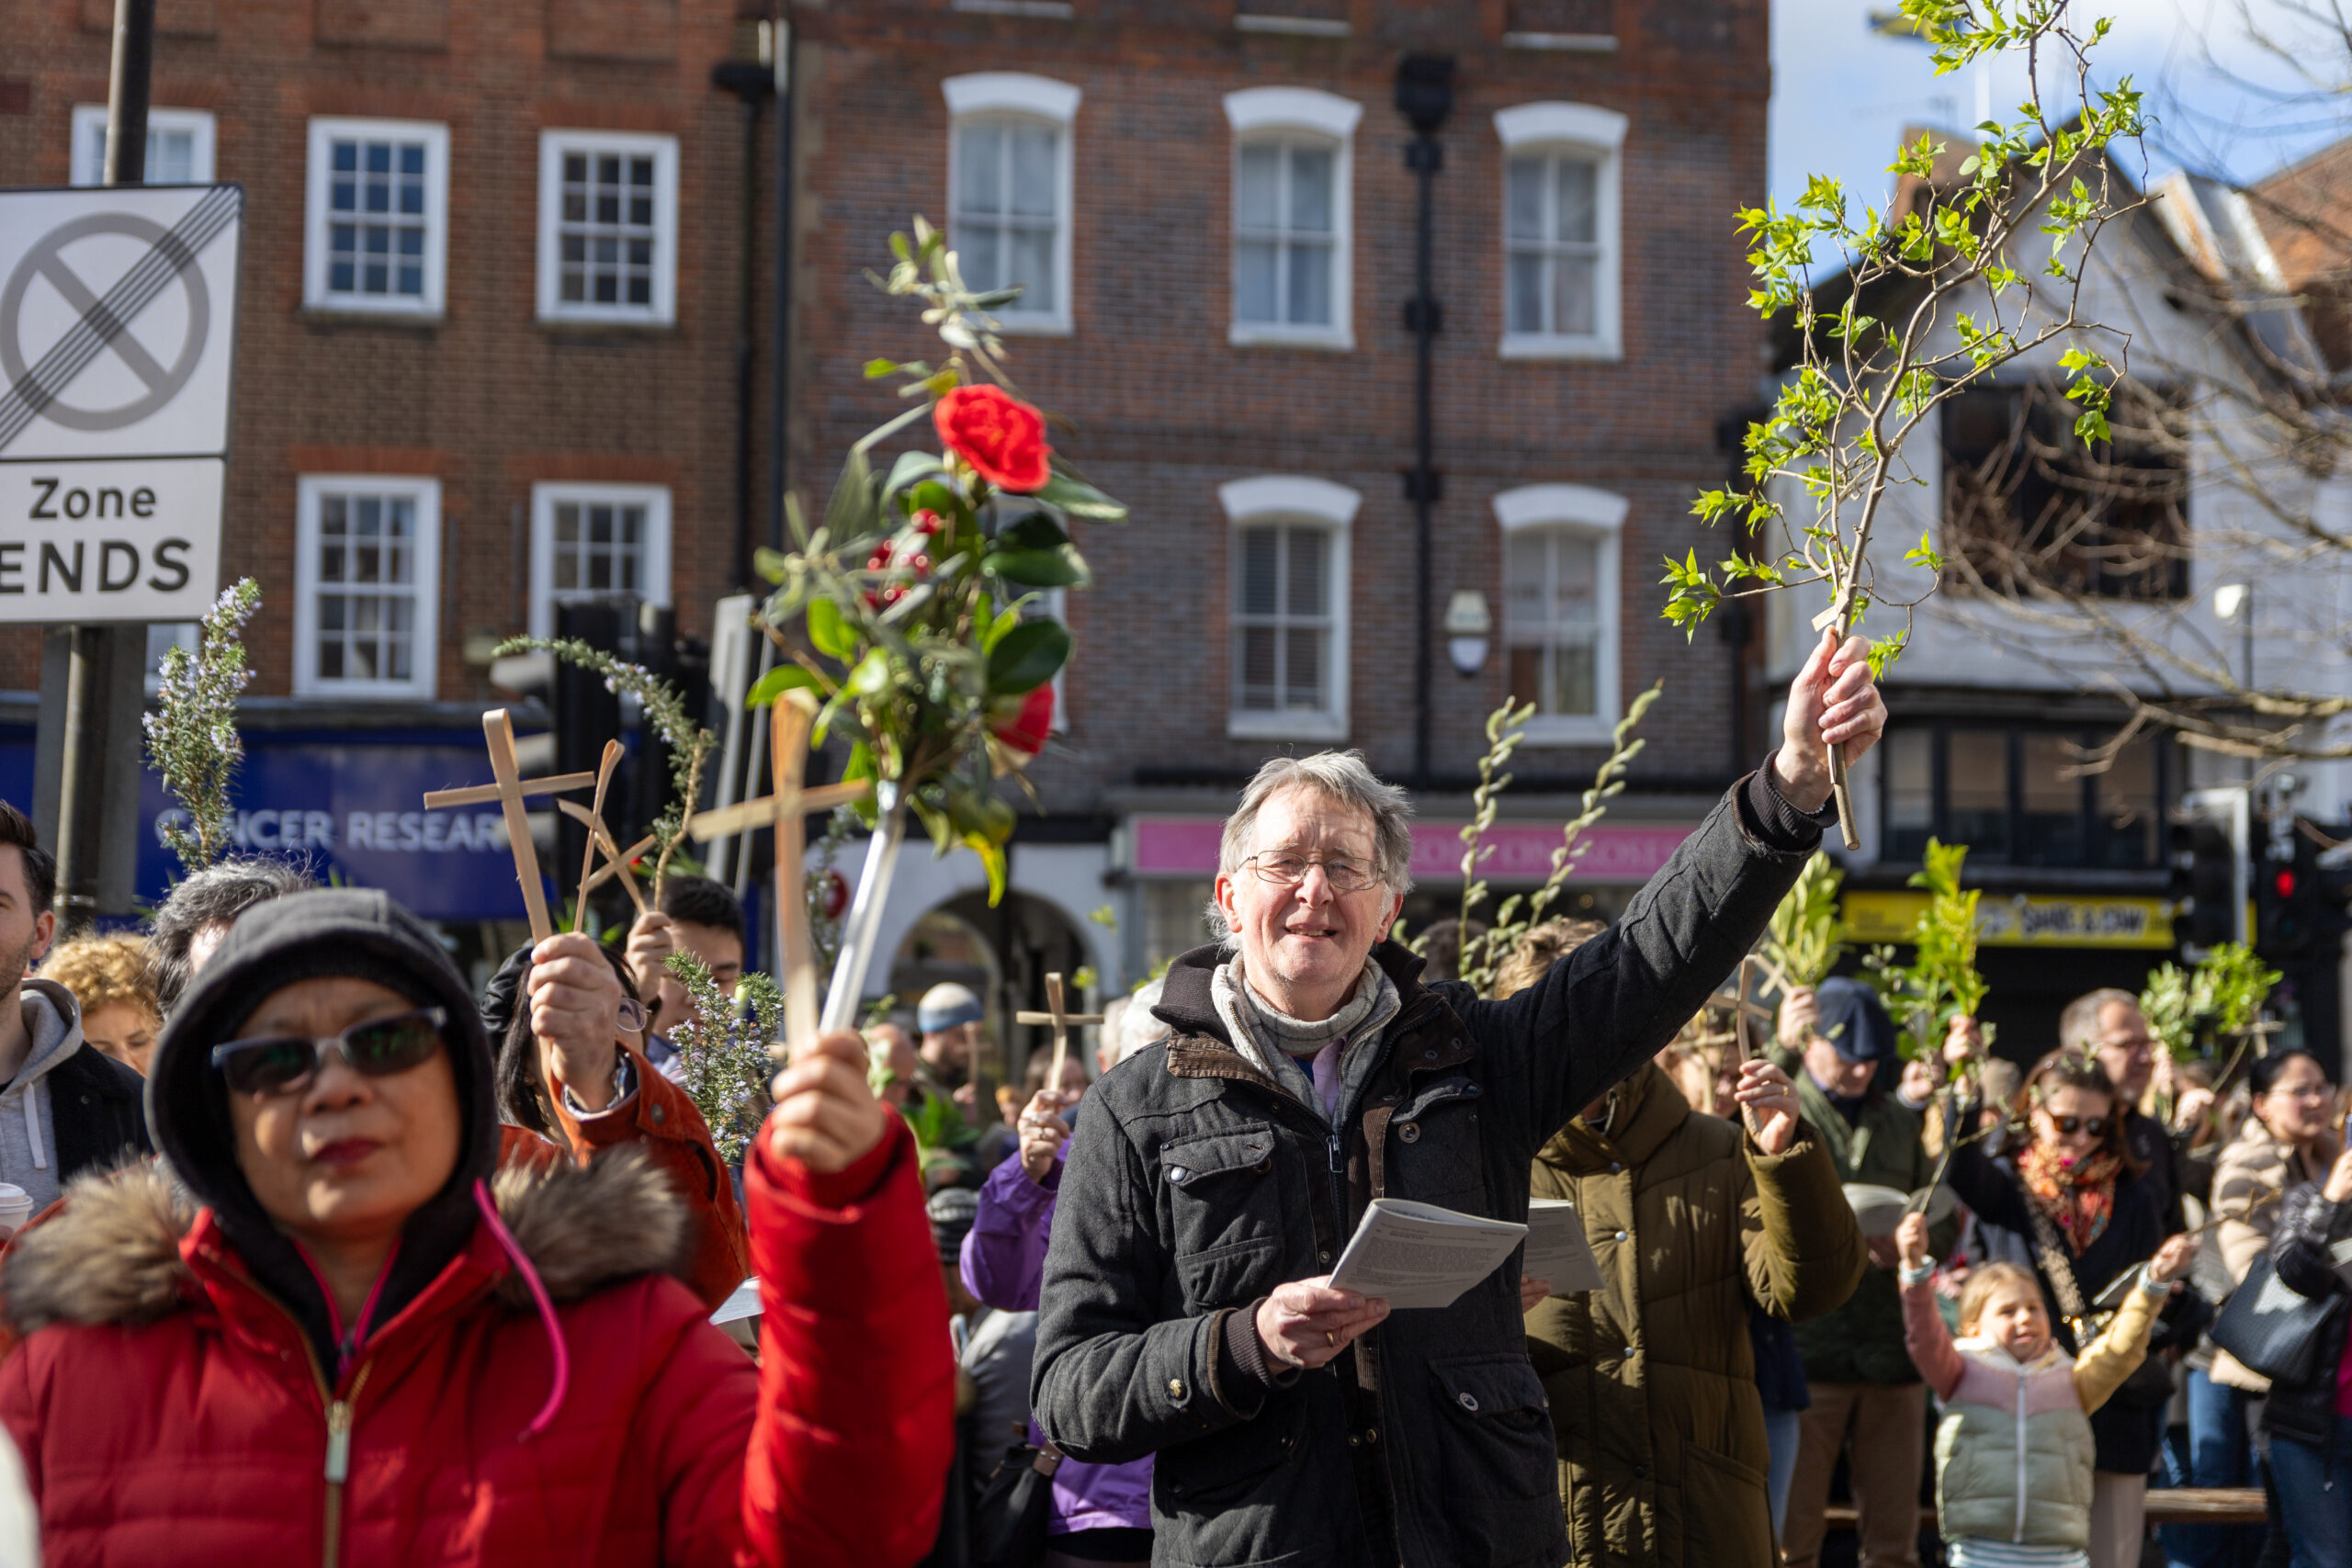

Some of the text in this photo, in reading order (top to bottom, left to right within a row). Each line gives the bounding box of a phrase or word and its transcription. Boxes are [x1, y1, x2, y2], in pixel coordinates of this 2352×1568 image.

[29, 479, 156, 518] Zone
[0, 538, 191, 593] ENDS
[154, 808, 334, 850] CNCER
